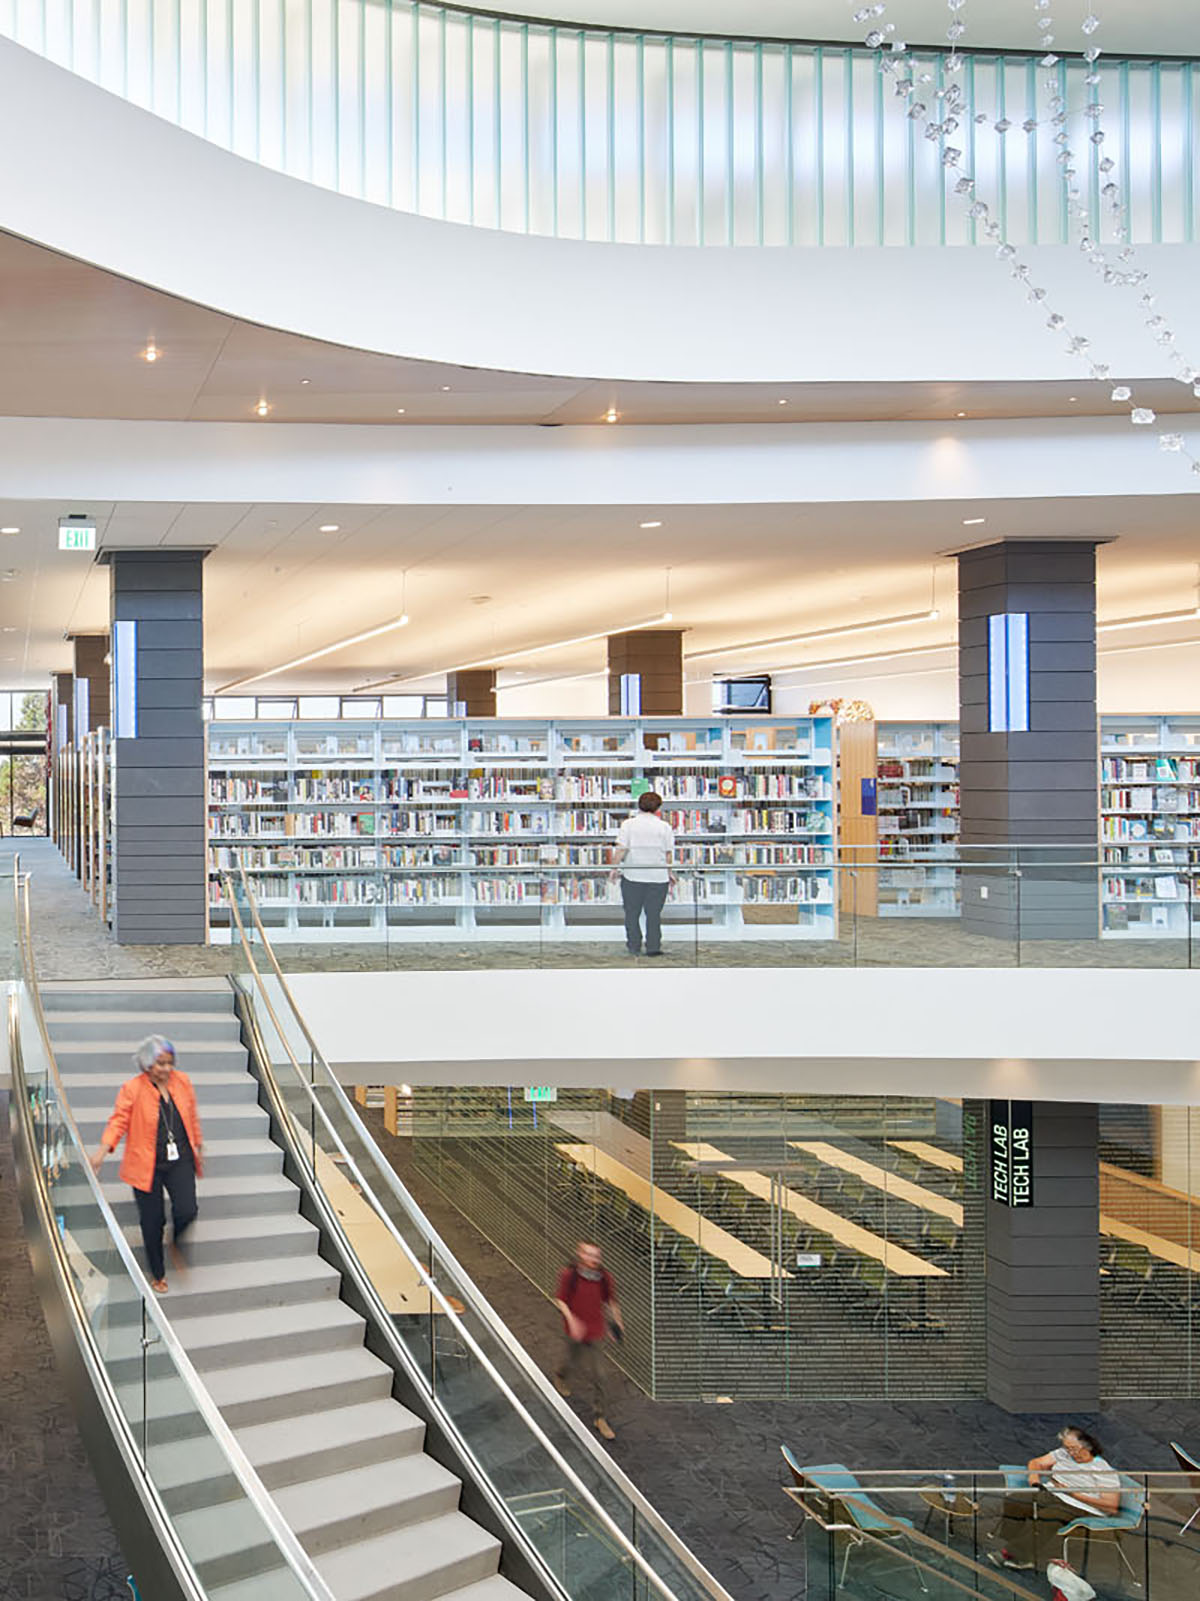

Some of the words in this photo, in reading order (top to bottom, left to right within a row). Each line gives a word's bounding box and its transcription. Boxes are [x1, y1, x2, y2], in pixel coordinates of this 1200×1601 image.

[66, 529, 89, 548] EXIT
[993, 1124, 1008, 1158] LAB
[1013, 1128, 1029, 1160] LAB
[993, 1160, 1008, 1201] TECH
[1013, 1165, 1029, 1206] TECH
